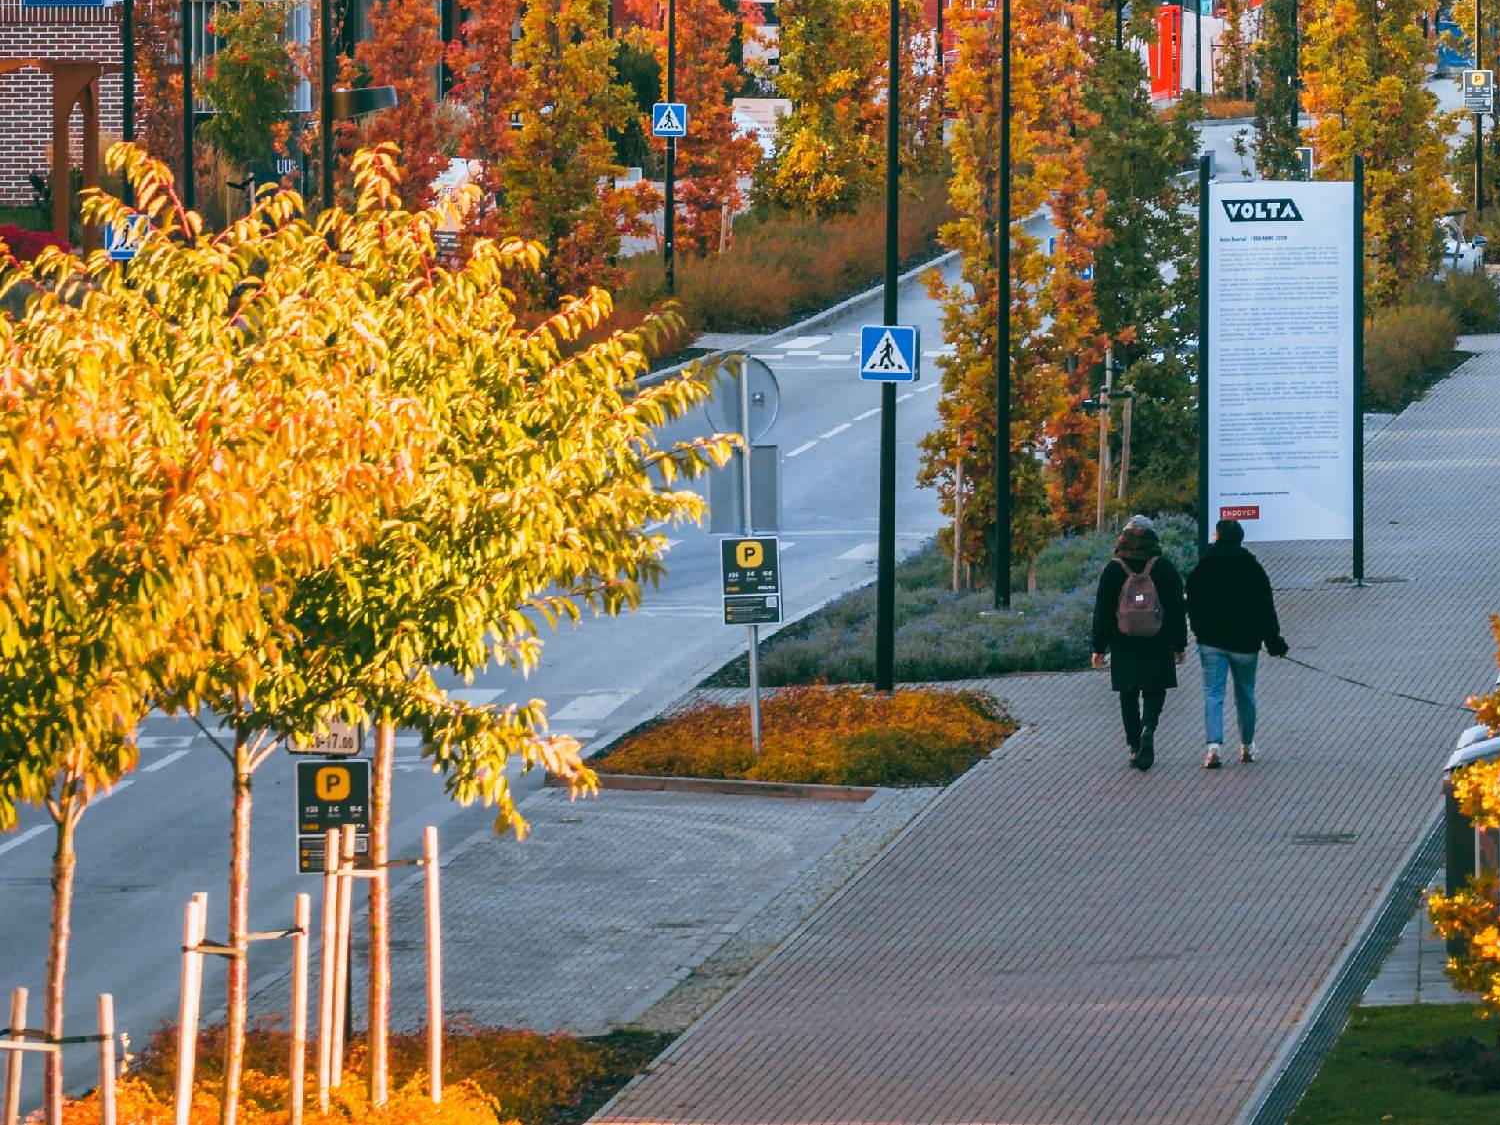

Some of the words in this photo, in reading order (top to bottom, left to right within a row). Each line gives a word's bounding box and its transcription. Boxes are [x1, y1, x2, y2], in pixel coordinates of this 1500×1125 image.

[1226, 202, 1296, 219] VOLTA
[744, 547, 756, 562] P
[325, 773, 341, 793] P
